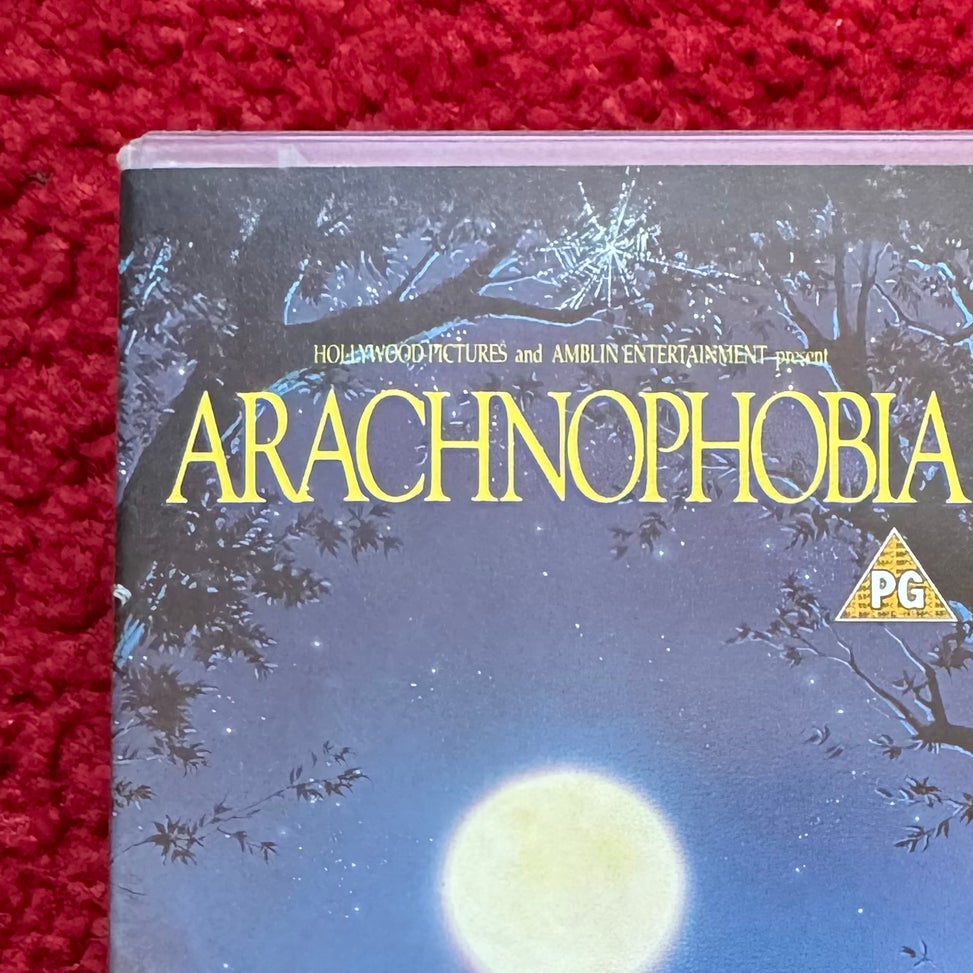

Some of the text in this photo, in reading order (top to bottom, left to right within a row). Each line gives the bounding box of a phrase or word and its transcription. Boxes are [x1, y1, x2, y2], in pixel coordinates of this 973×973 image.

[313, 343, 428, 364] HOLLYWOOD
[428, 342, 508, 364] PICTURES
[515, 344, 542, 363] and
[552, 344, 618, 364] AMBLIN
[623, 344, 767, 365] ENTERTAINMENT
[165, 388, 972, 506] ARACHNOPHOBIA
[869, 568, 927, 611] PG
